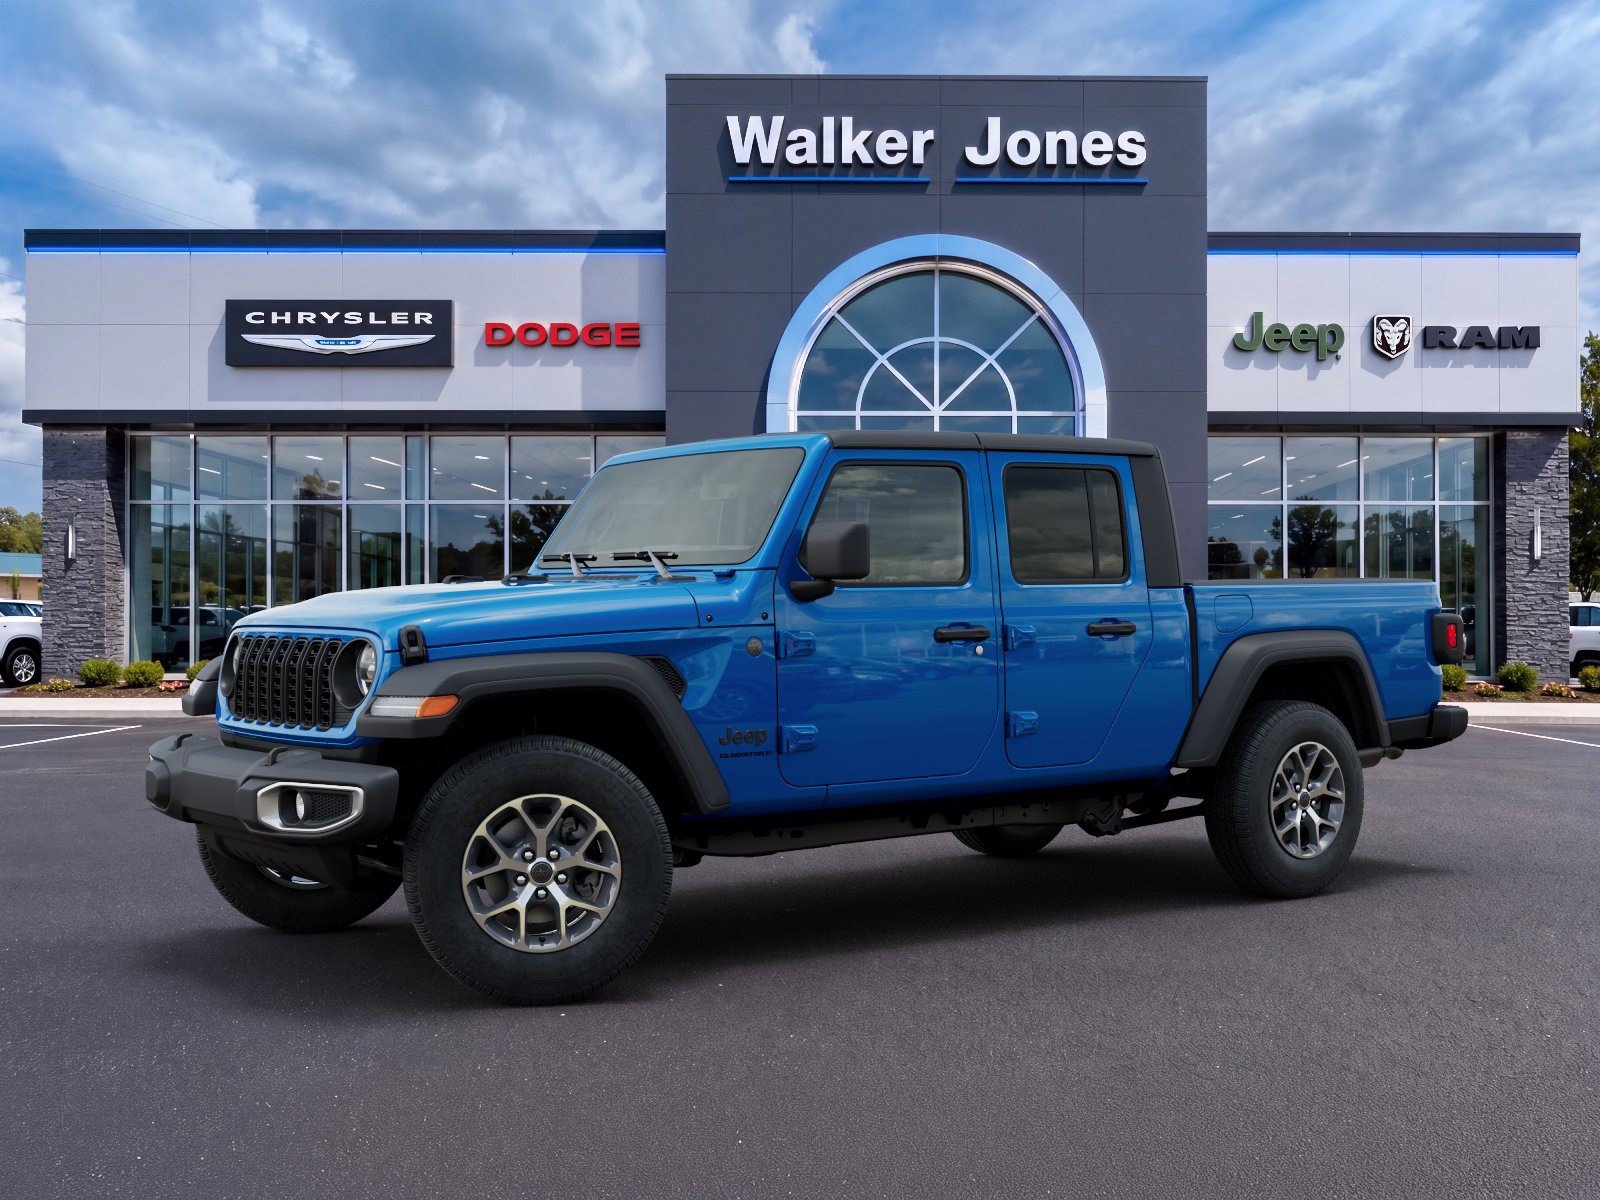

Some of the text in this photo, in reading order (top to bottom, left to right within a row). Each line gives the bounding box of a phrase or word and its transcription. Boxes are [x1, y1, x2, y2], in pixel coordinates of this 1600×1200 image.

[726, 115, 1147, 166] Walker Jones
[245, 311, 433, 325] CHRYSLER
[485, 322, 641, 347] DODGE
[1233, 311, 1345, 360] Jeep
[1423, 325, 1541, 350] RAM
[719, 727, 768, 747] Jeep
